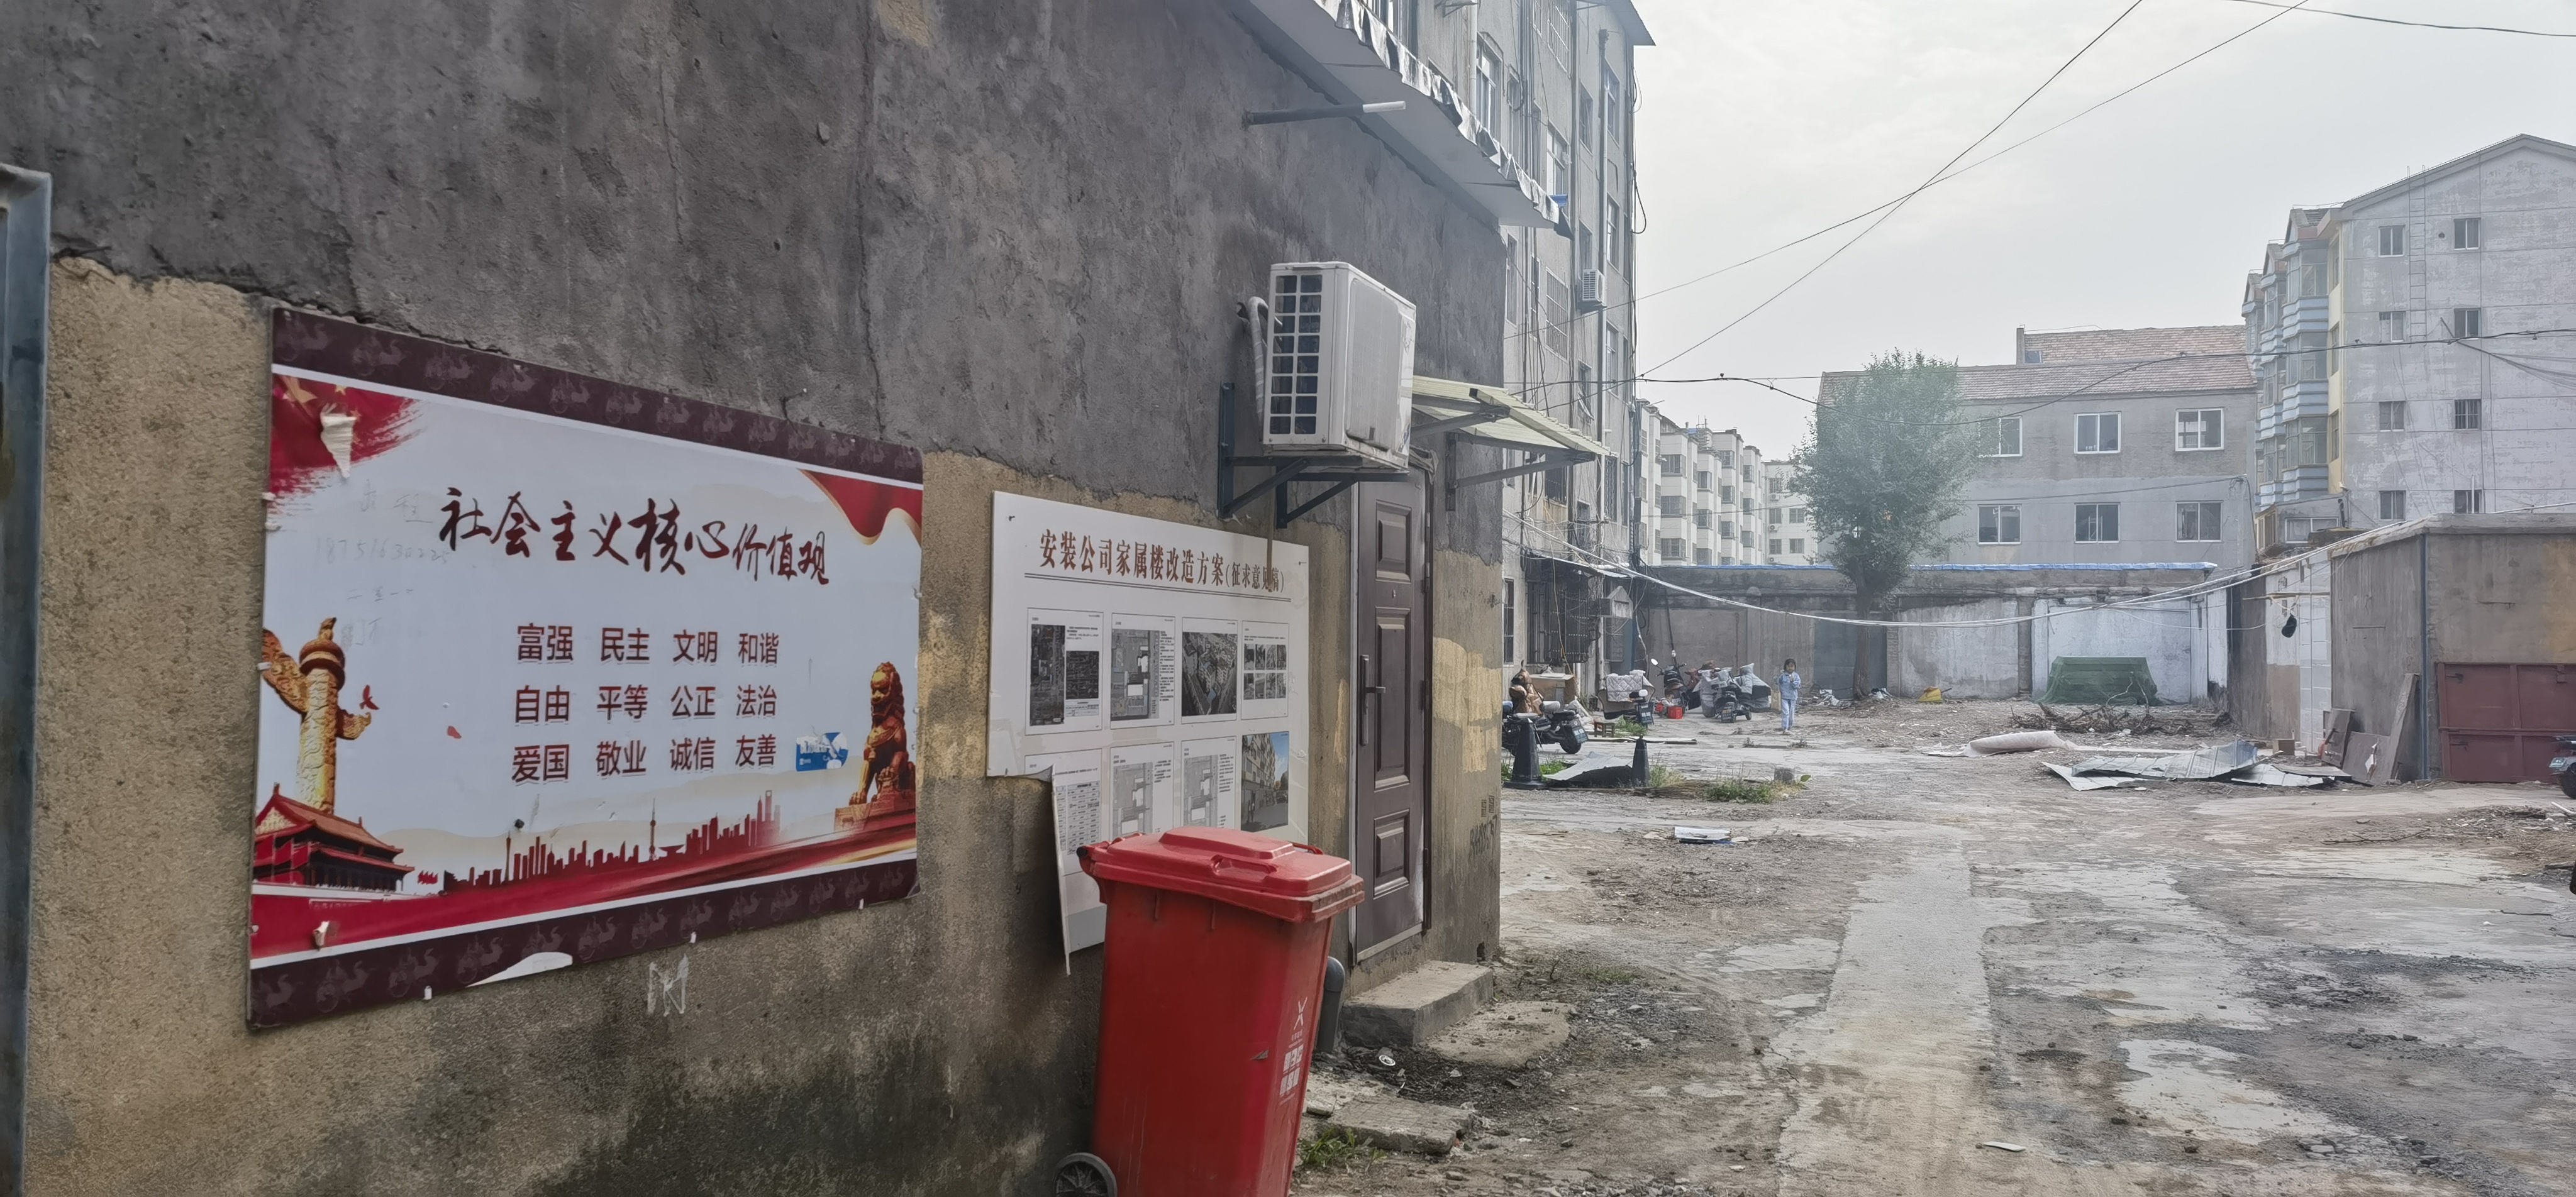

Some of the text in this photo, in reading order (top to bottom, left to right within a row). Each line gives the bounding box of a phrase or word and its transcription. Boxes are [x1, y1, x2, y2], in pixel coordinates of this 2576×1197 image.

[439, 487, 830, 585] 社会主义核心价值观
[517, 623, 779, 665] 富强 民主 文明 和谐
[514, 684, 777, 724] 自由 平等 公正 法治
[512, 744, 570, 784] 爱国
[596, 740, 647, 777] 敬业
[670, 736, 716, 773] 诚信
[735, 734, 777, 768] 友善
